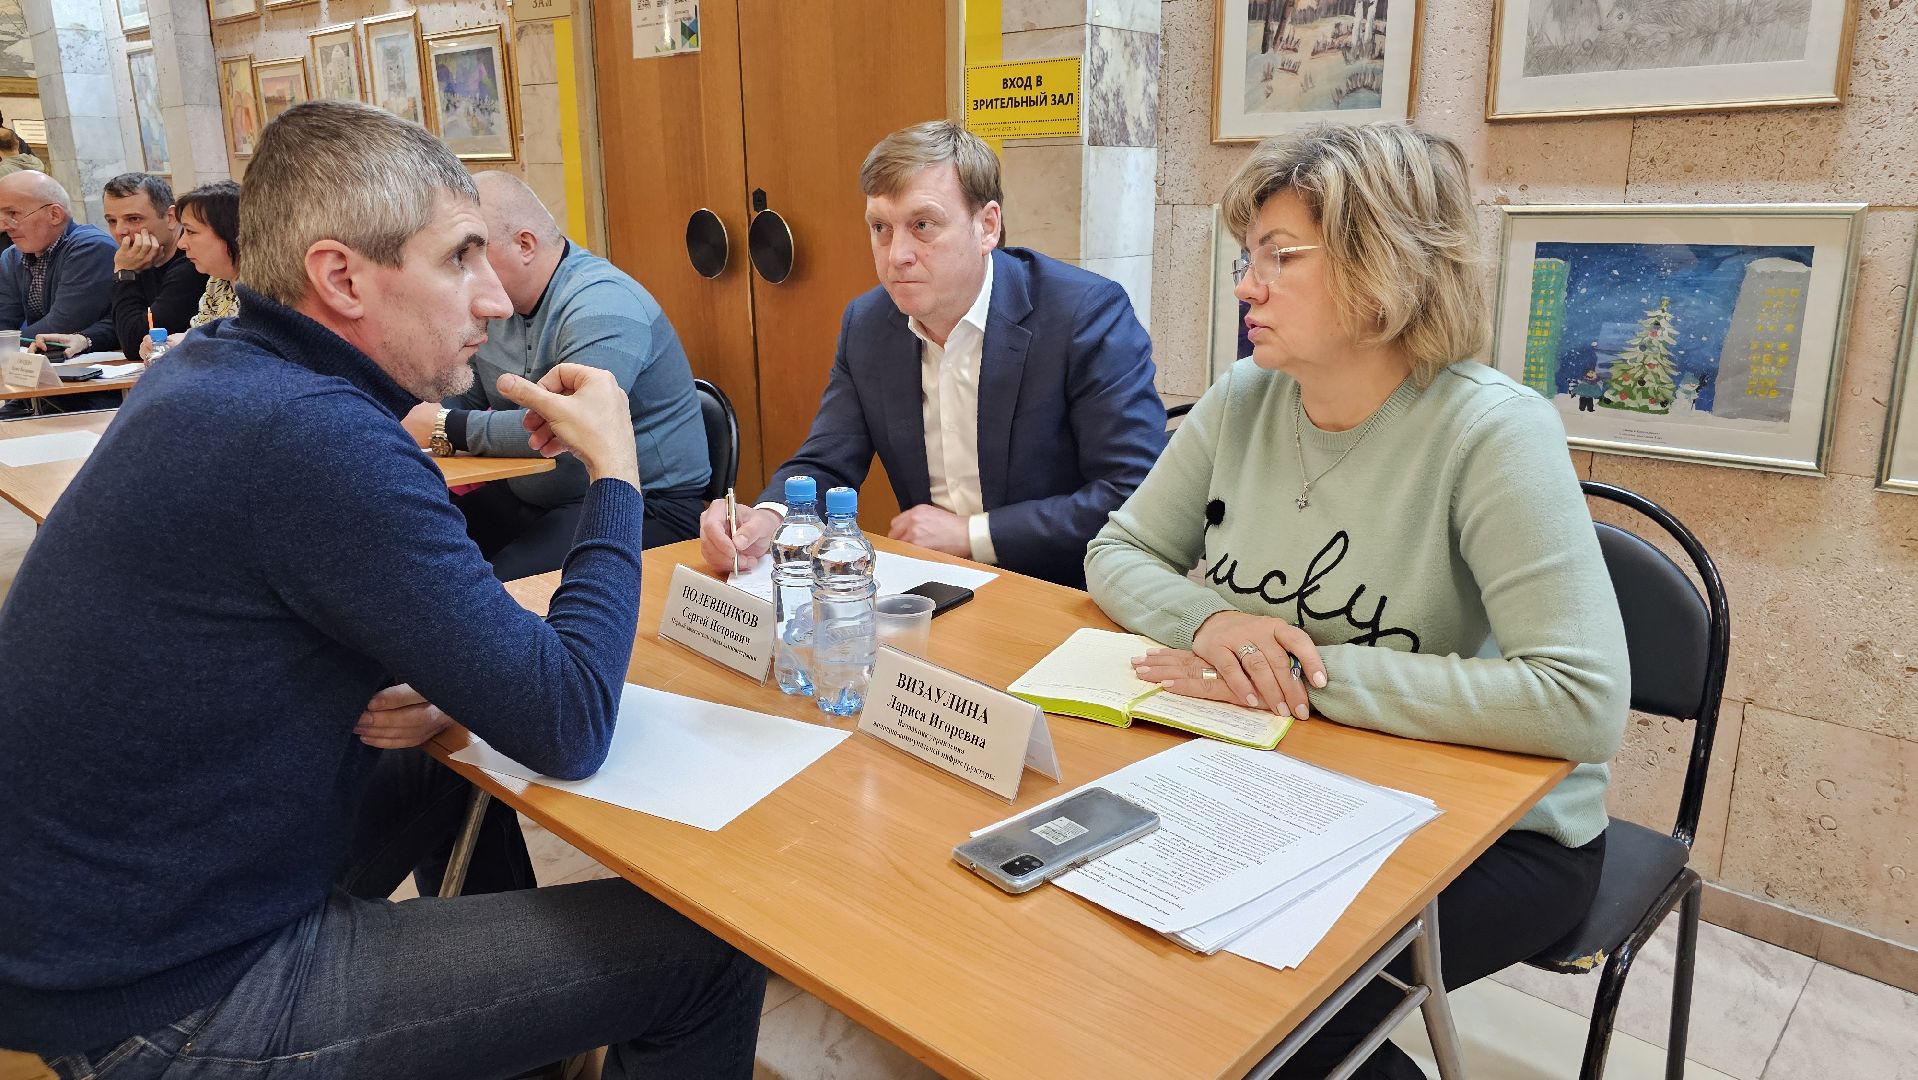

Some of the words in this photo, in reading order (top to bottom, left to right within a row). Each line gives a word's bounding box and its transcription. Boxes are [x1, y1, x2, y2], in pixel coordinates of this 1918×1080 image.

[973, 91, 1048, 111] ЗРИТЕЛЬНЫЙ
[1050, 93, 1074, 106] ЗАЛ
[1002, 75, 1032, 91] ВХОД
[1036, 75, 1043, 87] В
[682, 585, 759, 628] ПОЛЕВЩИКОВ
[1205, 530, 1420, 653] ucky
[682, 606, 709, 627] Сергей
[710, 618, 751, 645] Петрович
[896, 672, 988, 725] ВИЗАУЛИНА
[887, 694, 926, 722] Лариса
[929, 712, 987, 749] Игоревна
[940, 752, 996, 781] инфраструктуры
